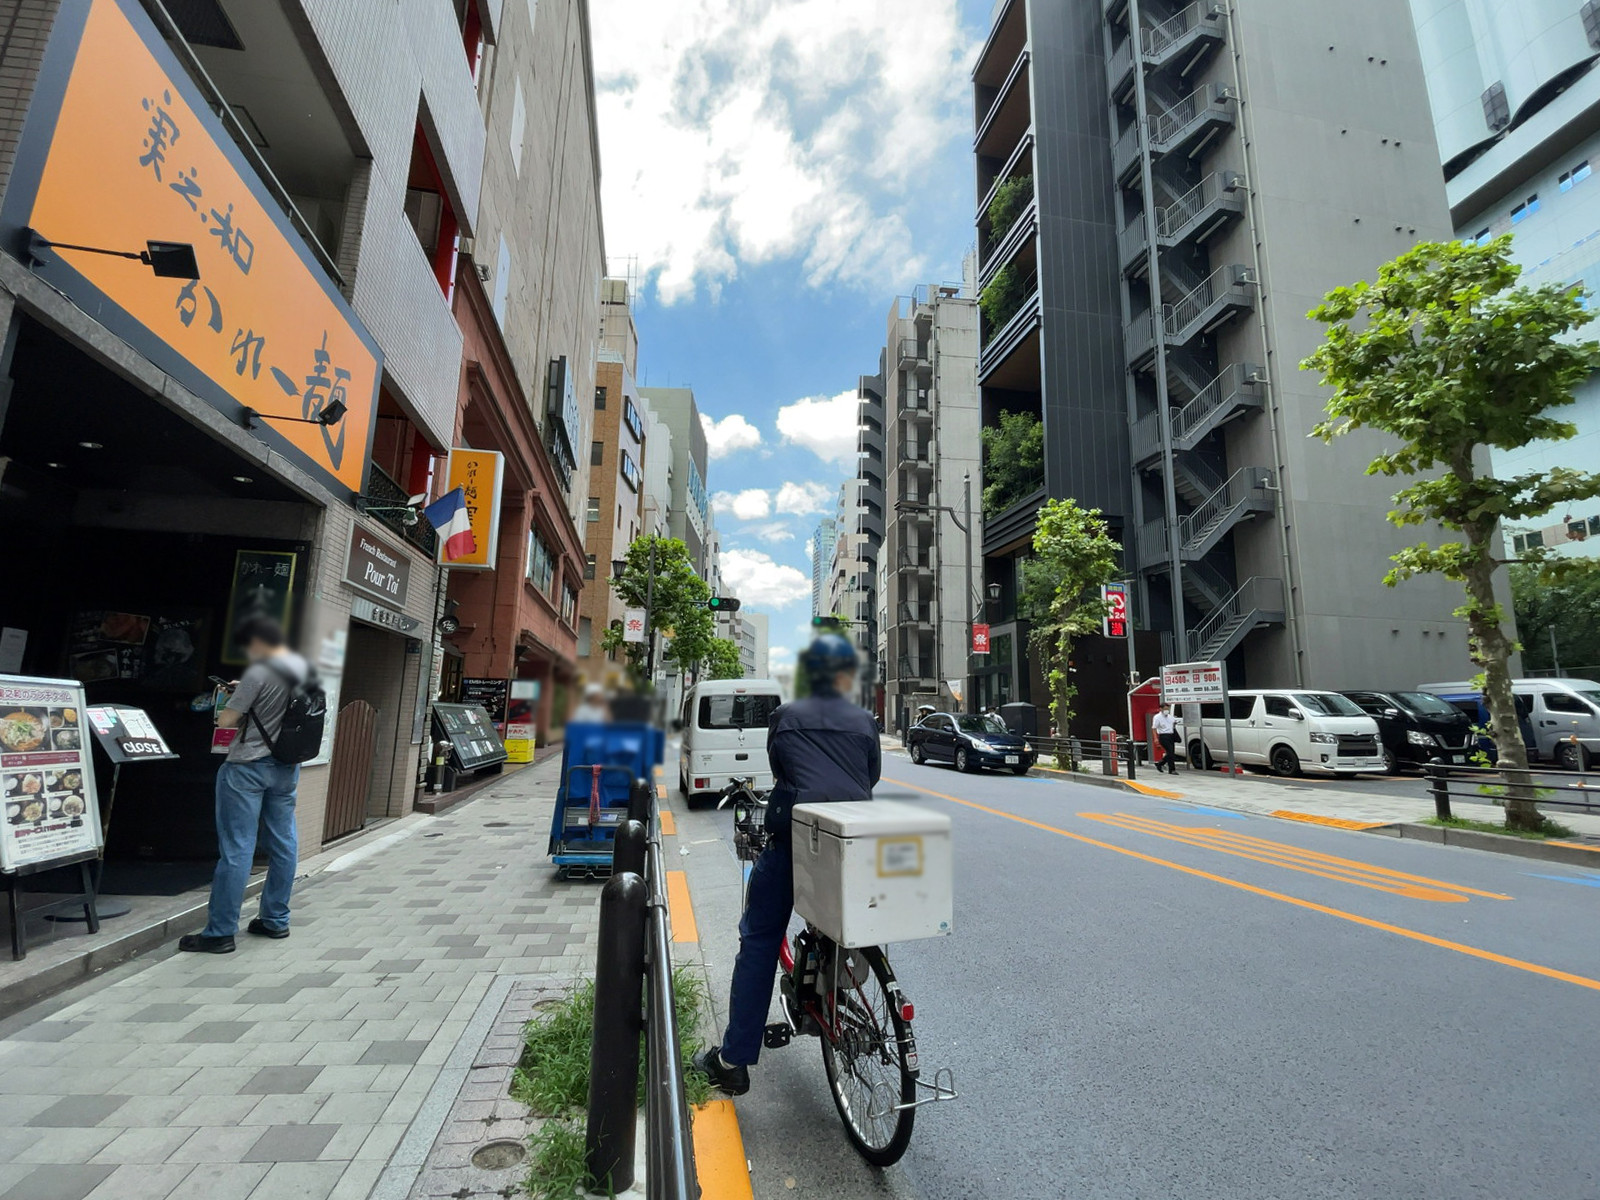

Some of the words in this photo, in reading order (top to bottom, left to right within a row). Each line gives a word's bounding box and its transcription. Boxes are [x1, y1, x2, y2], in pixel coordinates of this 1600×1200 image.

[359, 538, 376, 556] French
[375, 548, 397, 568] Restaurant
[364, 561, 385, 587] Pour
[386, 573, 400, 595] Toi
[627, 619, 643, 631] 祭
